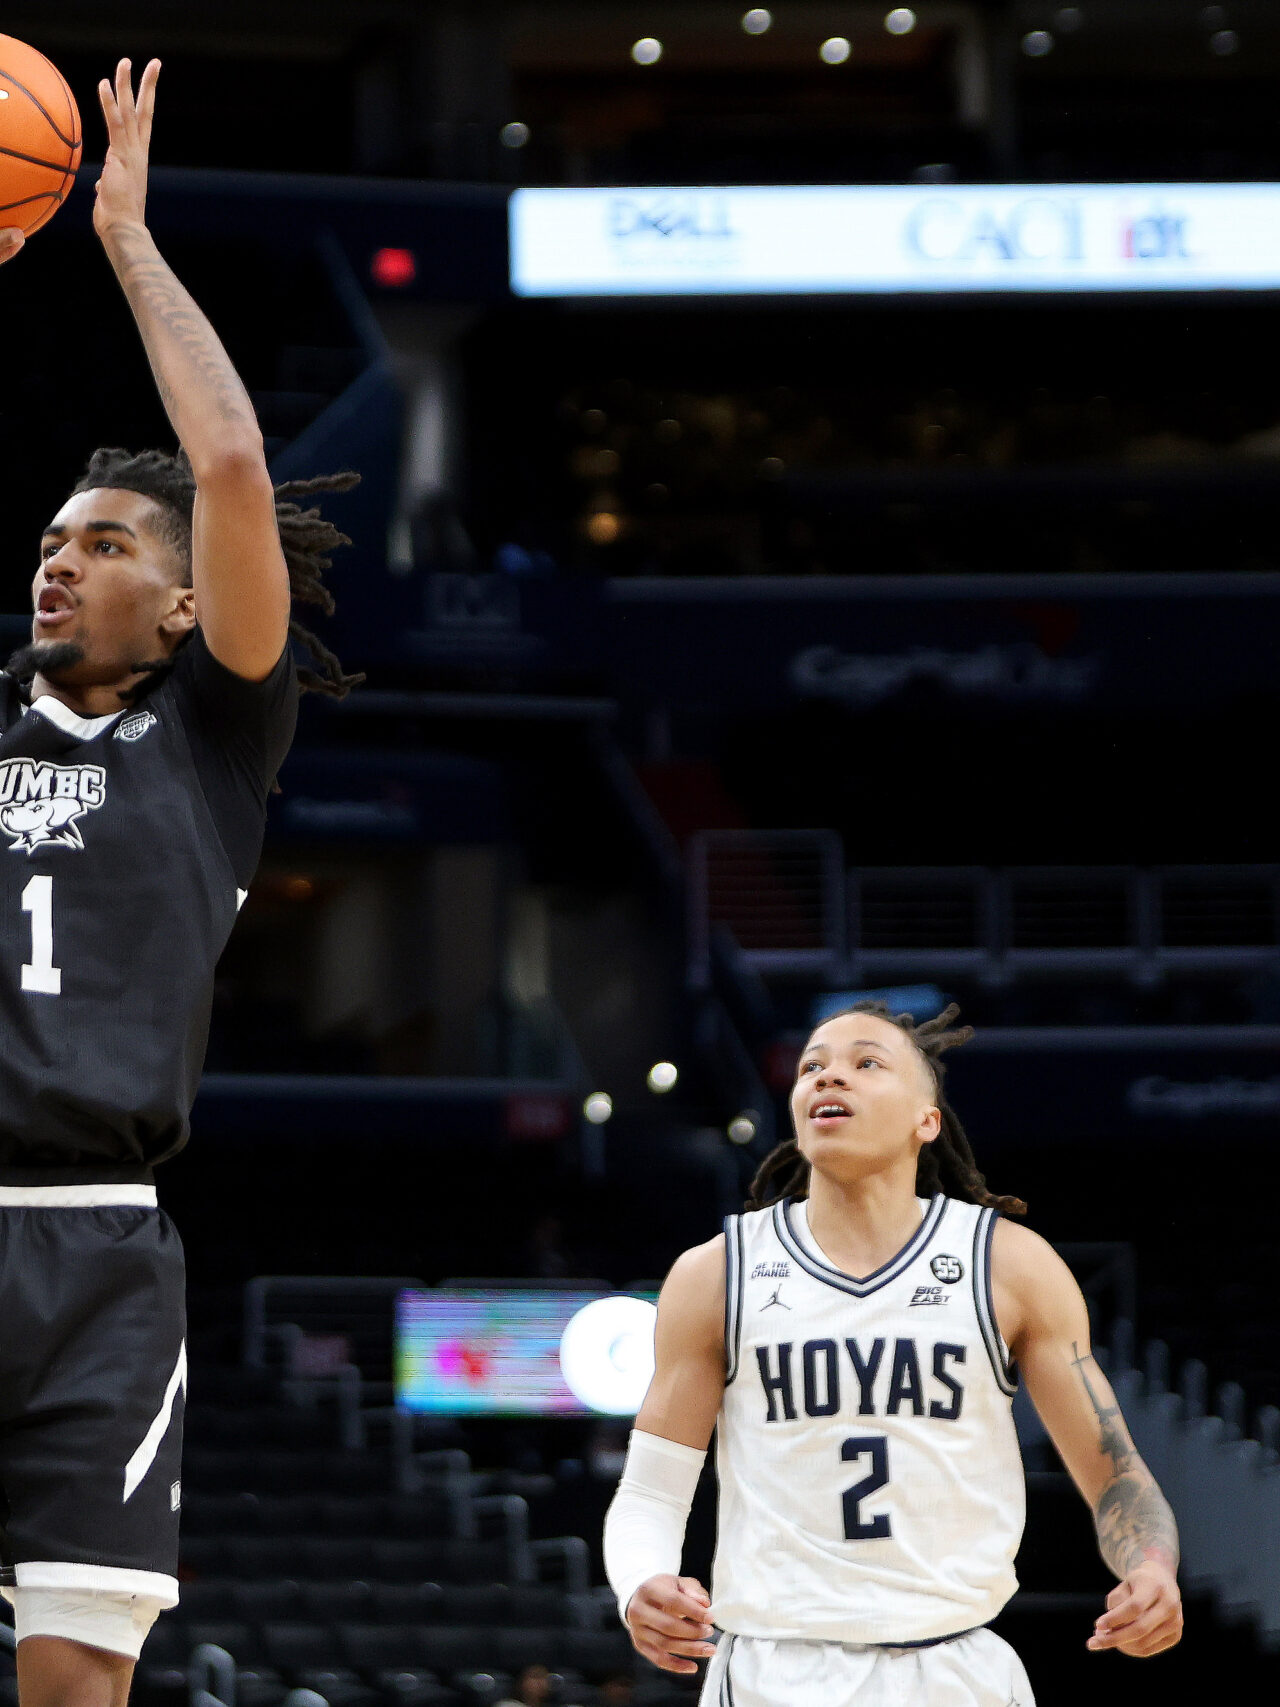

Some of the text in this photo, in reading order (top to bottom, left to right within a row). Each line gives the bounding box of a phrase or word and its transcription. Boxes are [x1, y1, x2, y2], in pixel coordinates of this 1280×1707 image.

[609, 196, 734, 236] DELL
[903, 197, 1088, 261] CACI
[21, 874, 61, 995] 1
[751, 1269, 790, 1279] CHANGE
[910, 1294, 952, 1303] EAST
[915, 1286, 943, 1294] BIG
[755, 1337, 967, 1423] HOYAS
[839, 1436, 893, 1542] 2
